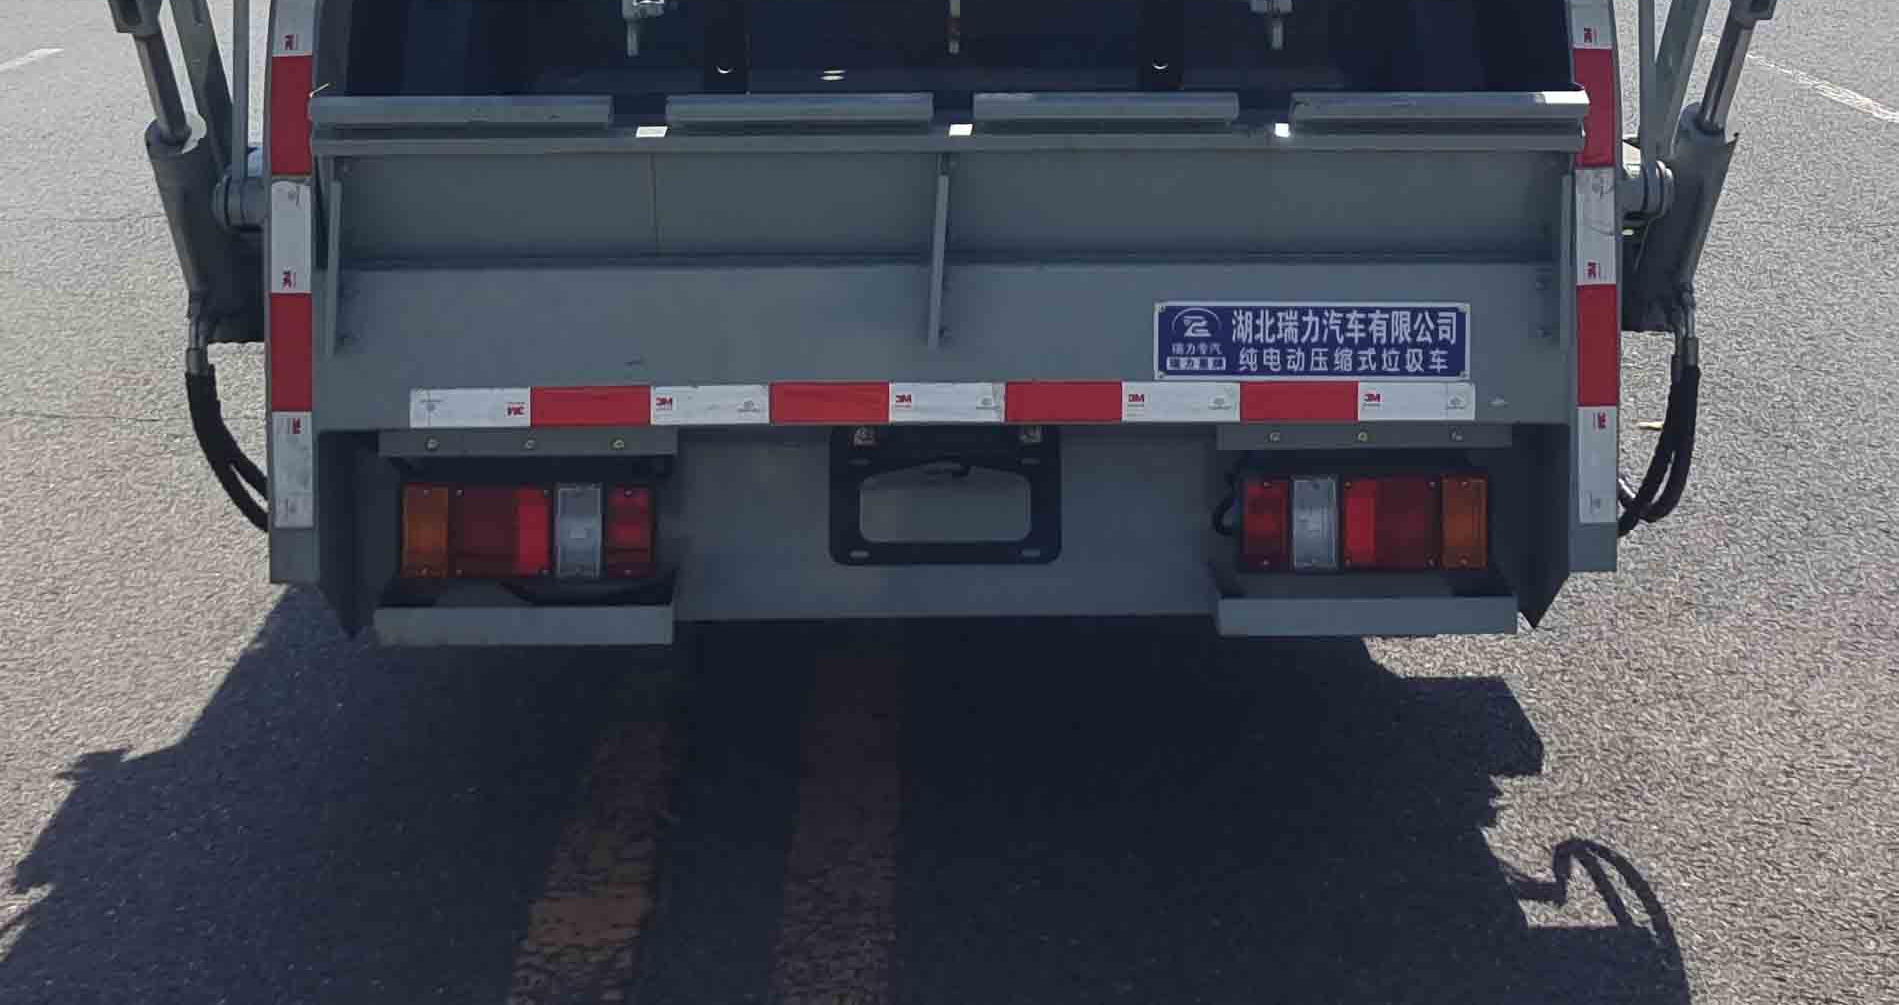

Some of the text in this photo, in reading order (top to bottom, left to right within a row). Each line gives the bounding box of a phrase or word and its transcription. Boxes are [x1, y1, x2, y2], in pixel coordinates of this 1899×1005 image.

[1231, 309, 1457, 344] 湖北瑞力汽车有限公司
[1239, 346, 1449, 372] 纯电动压缩式垃圾车
